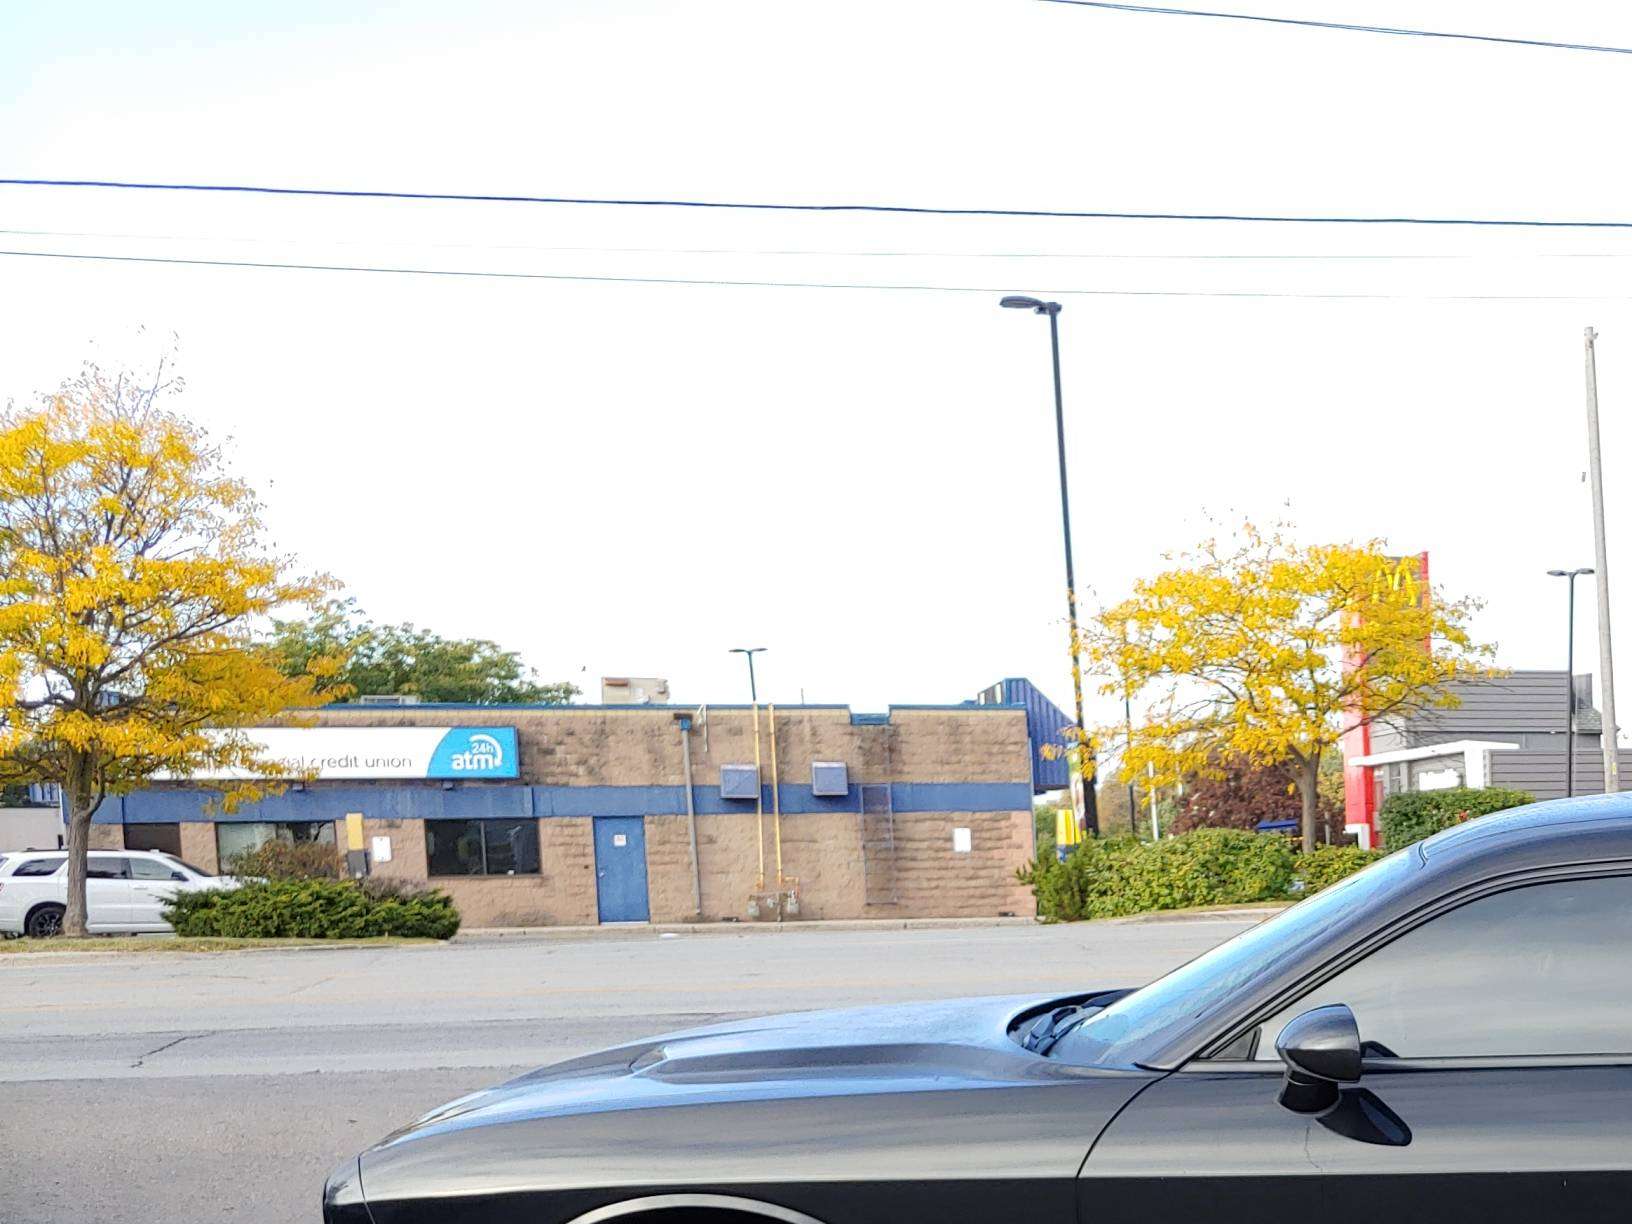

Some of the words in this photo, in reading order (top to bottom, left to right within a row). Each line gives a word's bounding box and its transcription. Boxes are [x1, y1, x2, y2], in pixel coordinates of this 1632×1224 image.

[471, 742, 494, 754] 24h
[365, 757, 412, 769] union
[451, 751, 494, 770] atm
